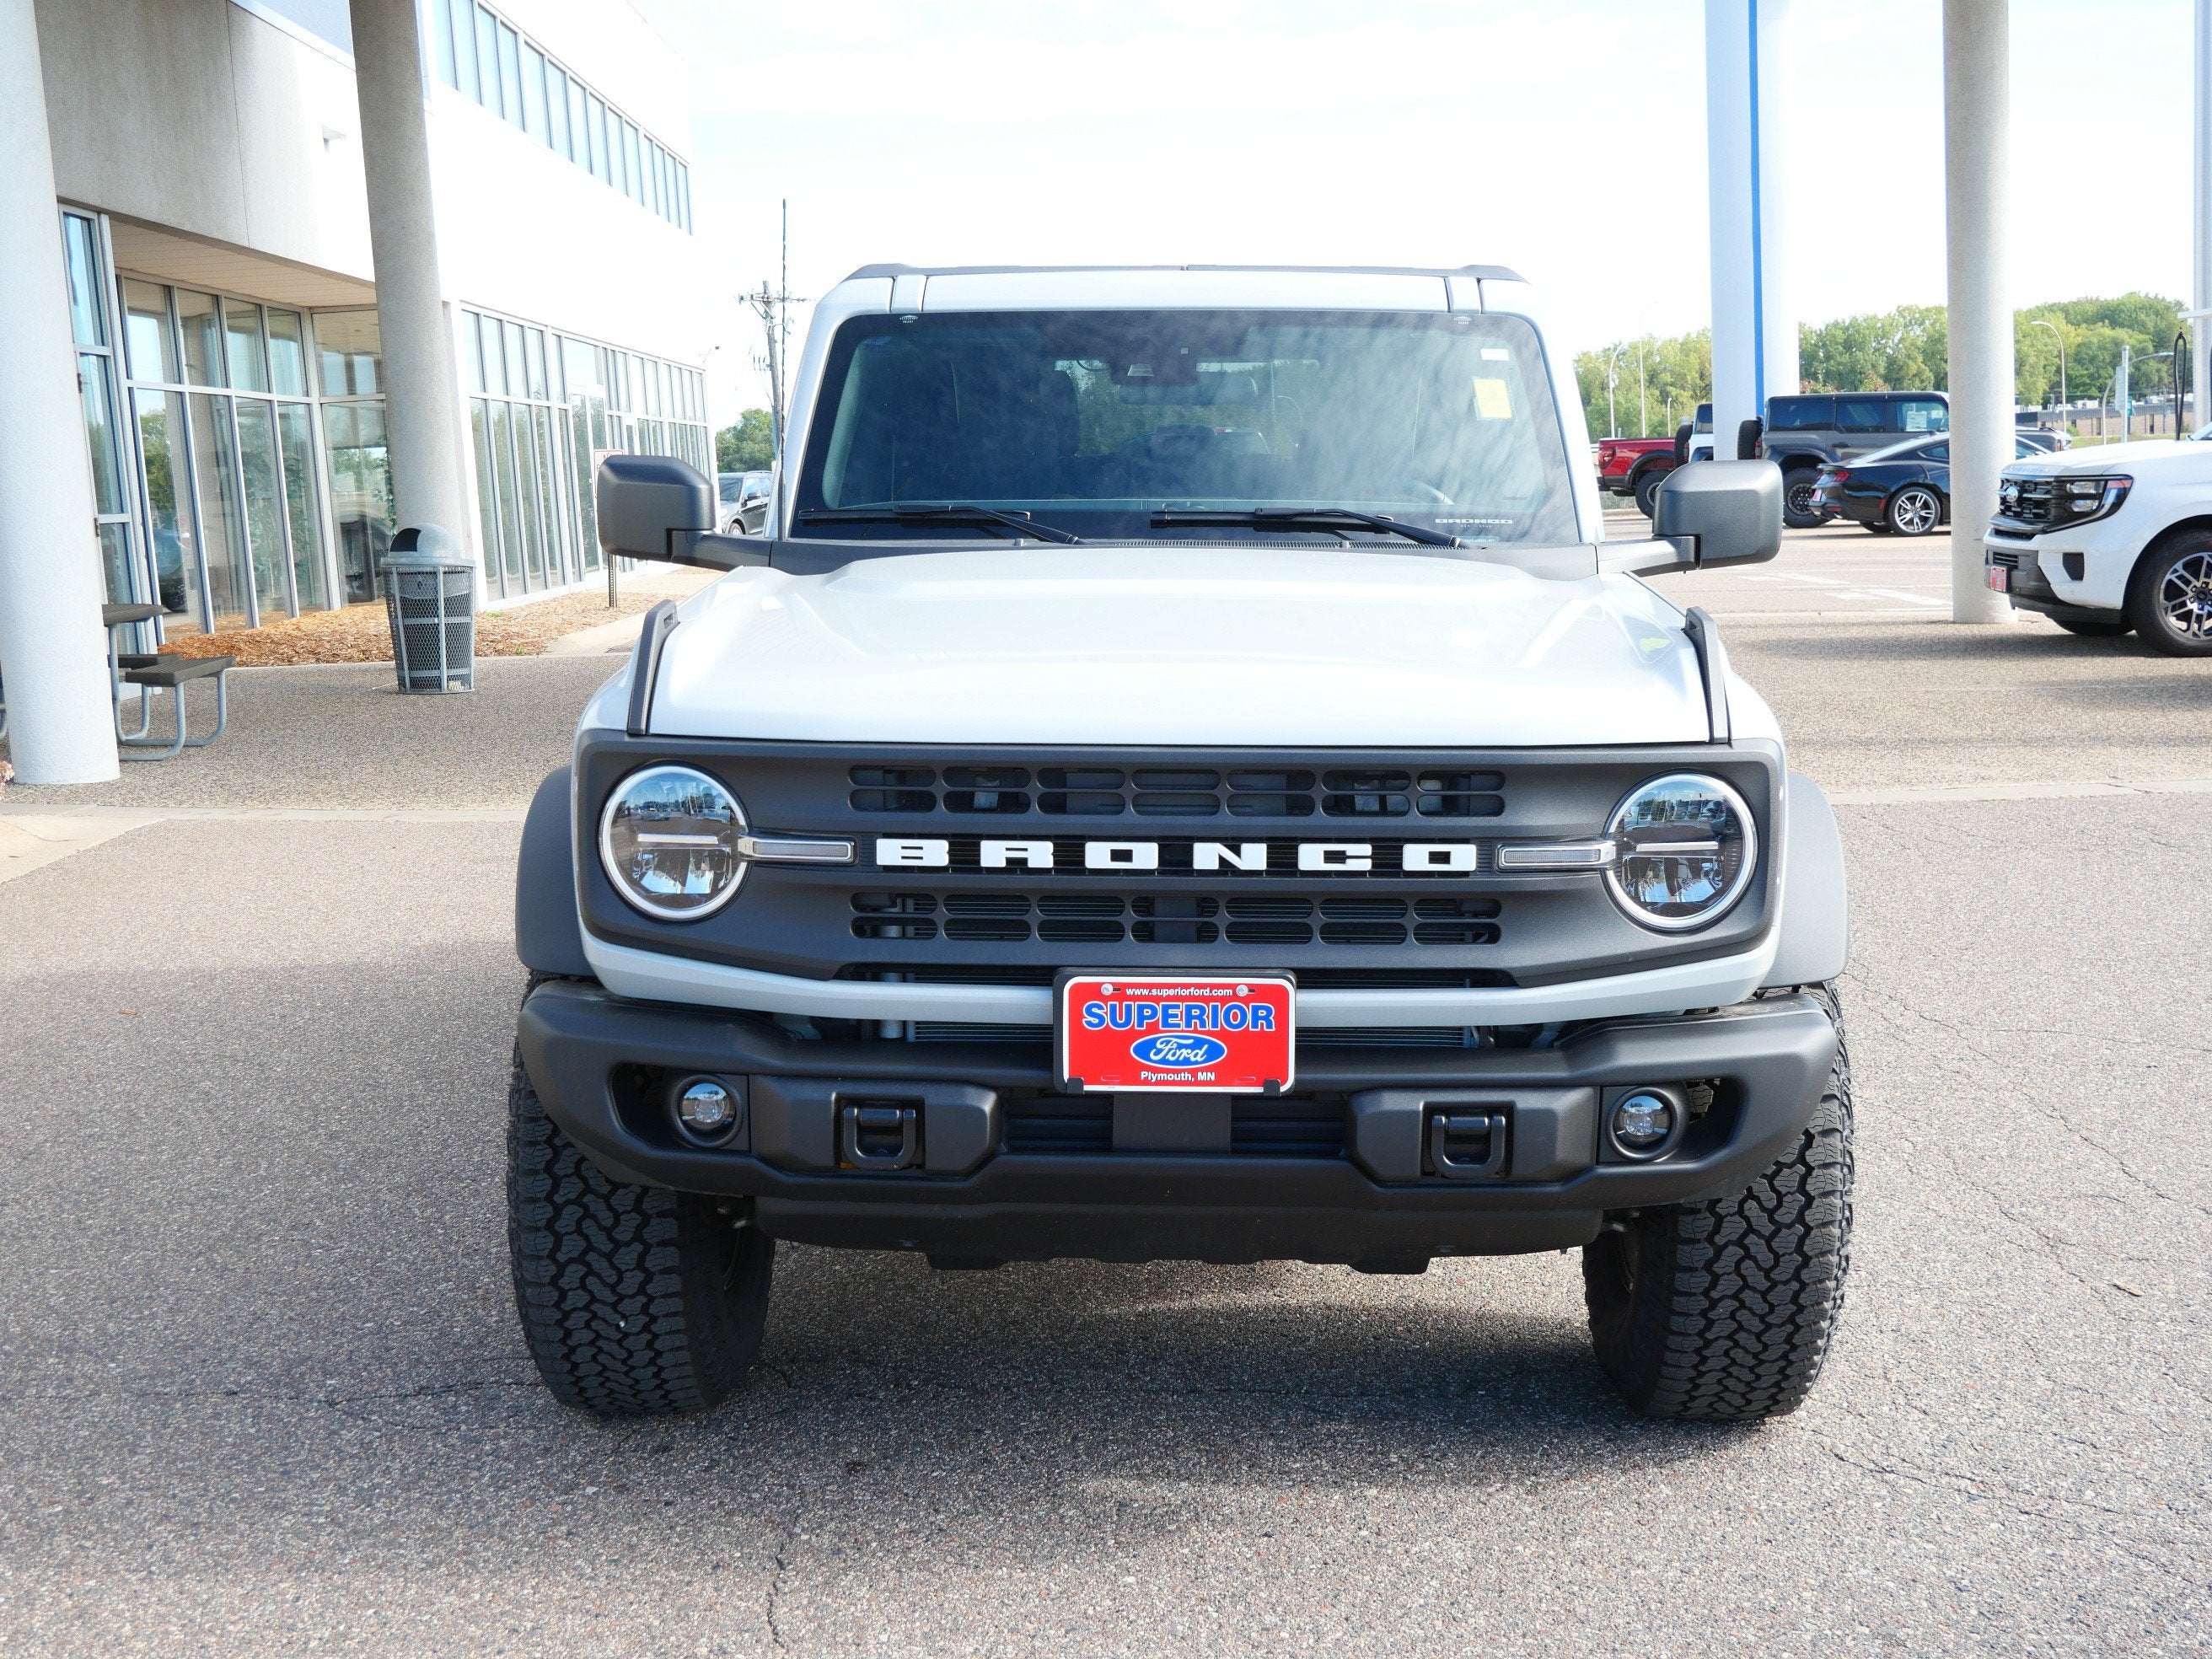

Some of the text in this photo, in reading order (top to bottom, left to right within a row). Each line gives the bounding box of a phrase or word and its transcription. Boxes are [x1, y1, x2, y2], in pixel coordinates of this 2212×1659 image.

[876, 838, 1477, 871] BRONCO
[1125, 986, 1233, 997] www.superiorford.com
[1082, 1001, 1275, 1032] SUPERIOR
[1149, 1037, 1207, 1062] Ford
[1141, 1071, 1216, 1082] Plymouth, MN
